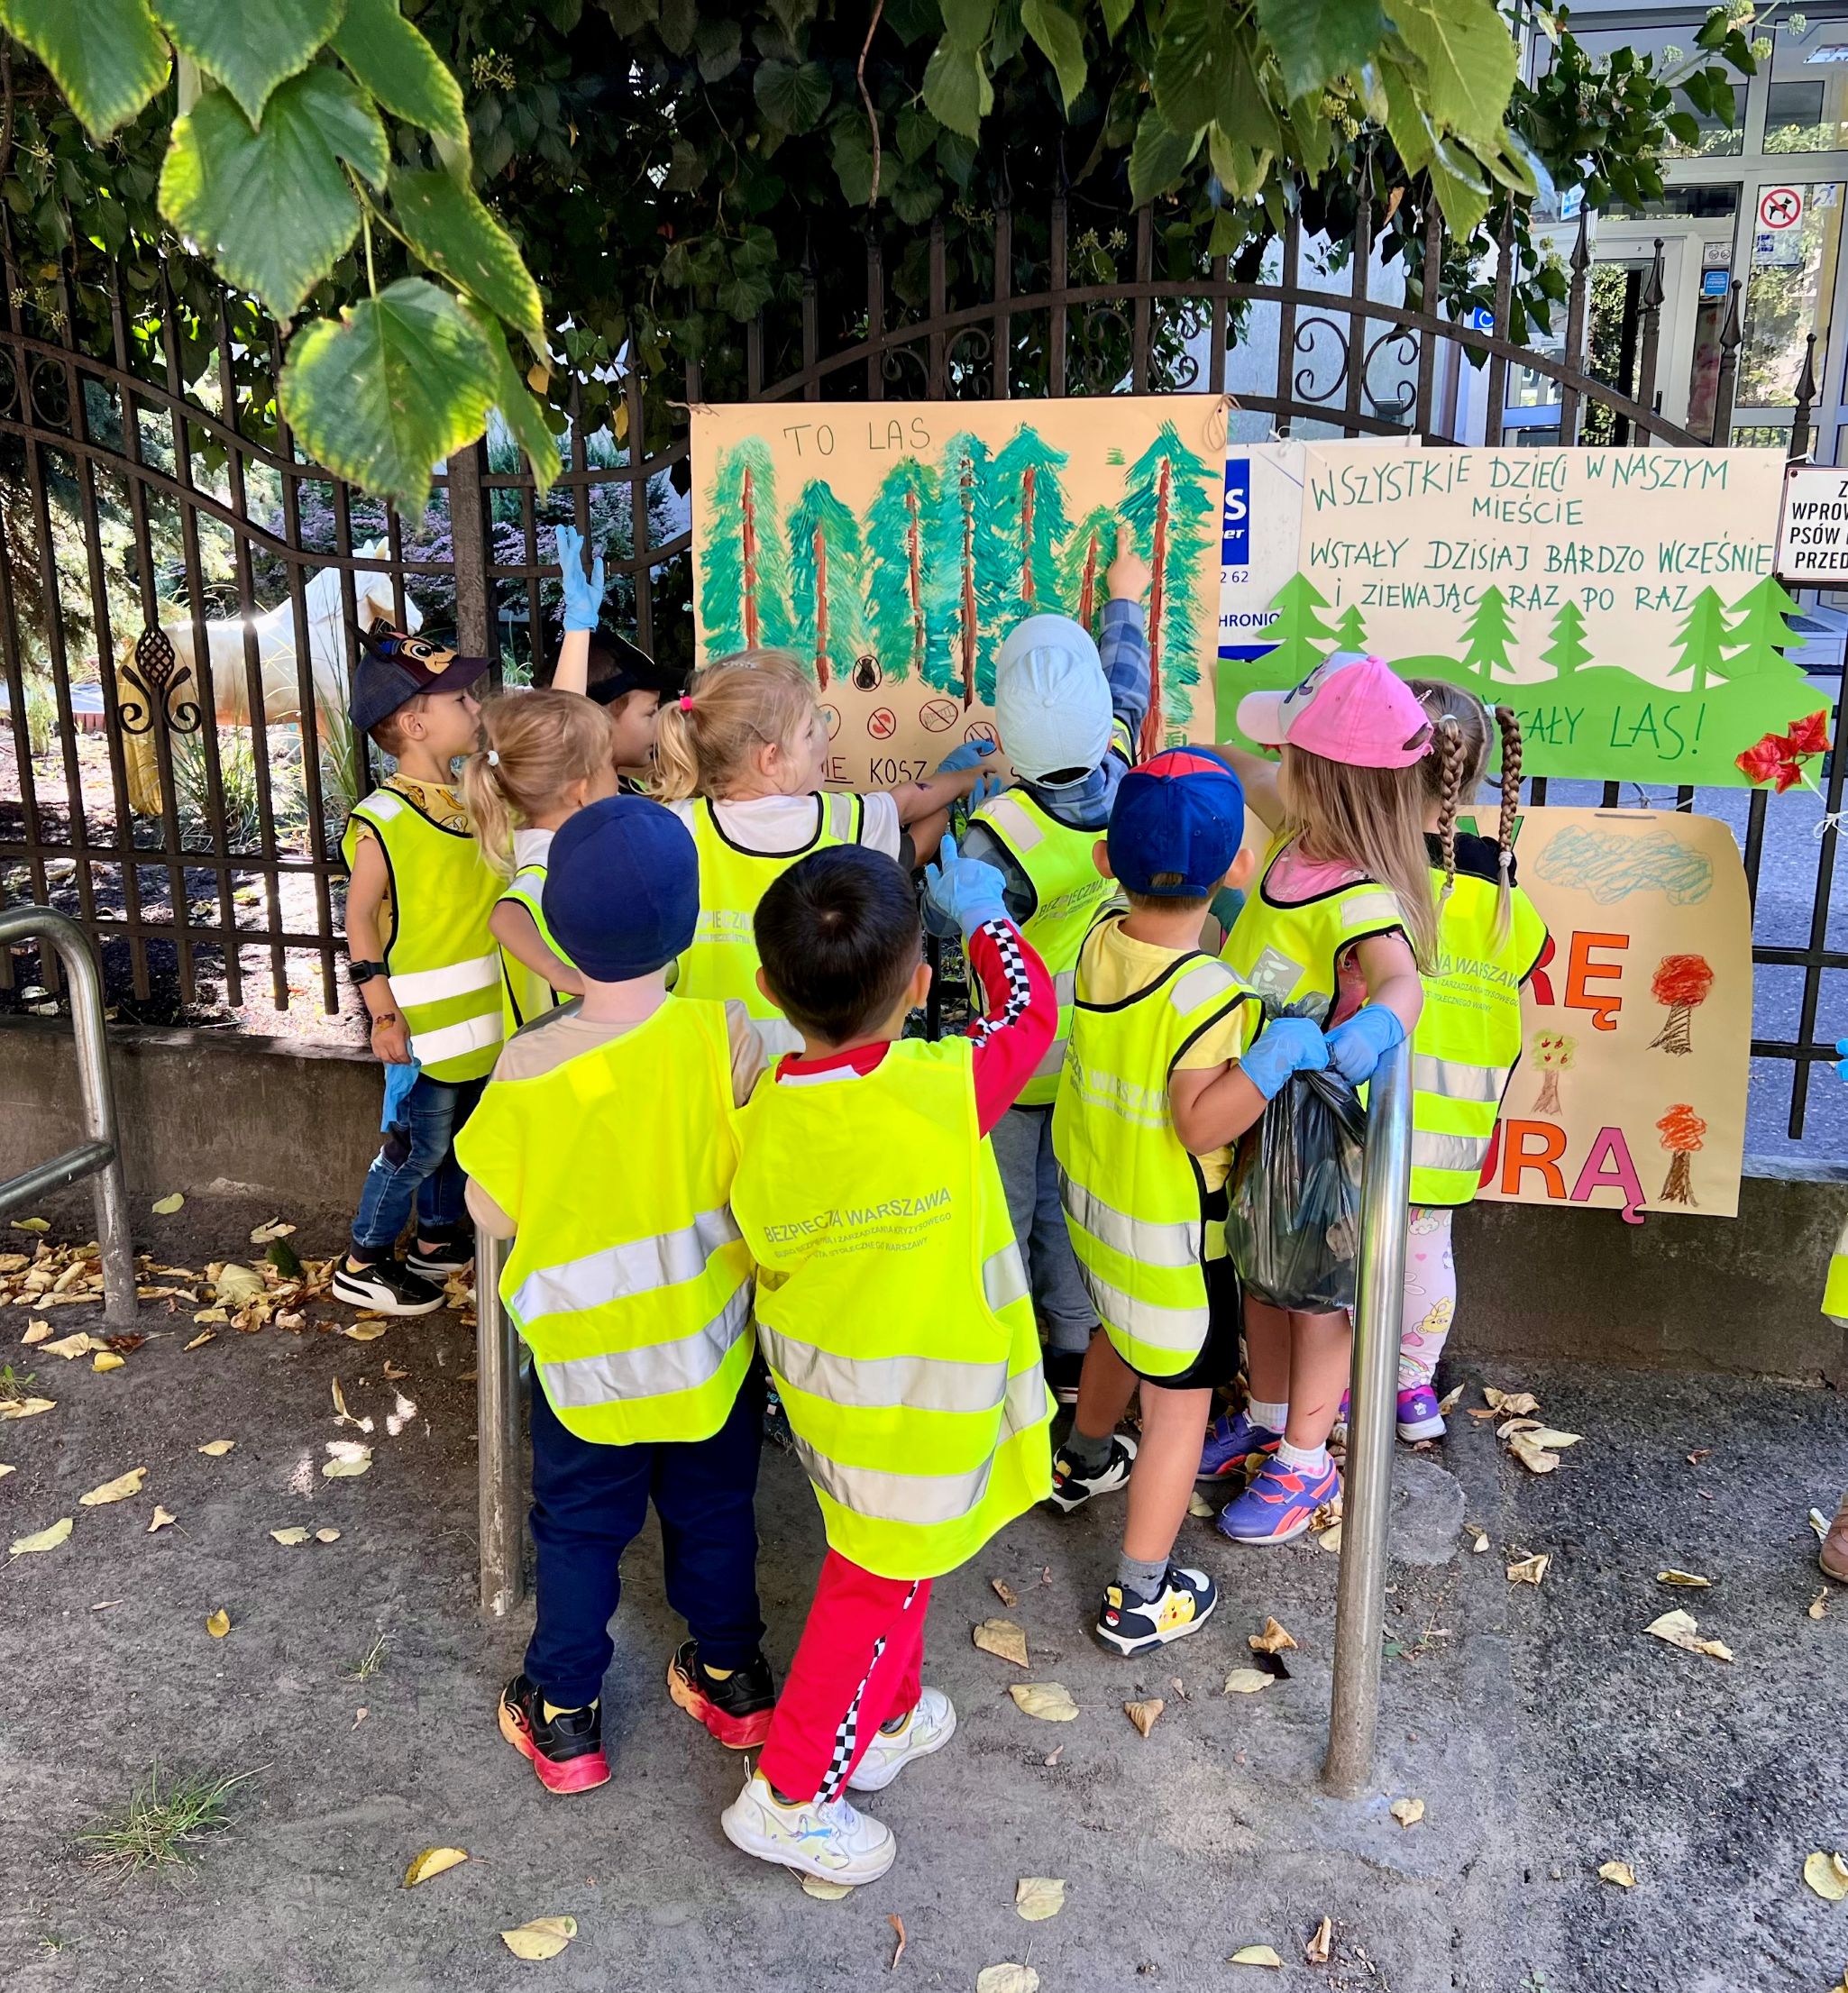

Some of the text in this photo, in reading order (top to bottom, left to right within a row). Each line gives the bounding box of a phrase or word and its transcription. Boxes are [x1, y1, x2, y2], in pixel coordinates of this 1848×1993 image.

[782, 416, 931, 456] TO LAS
[1586, 453, 1606, 480] W
[1611, 453, 1729, 490] NASZYM
[1789, 522, 1841, 545] PSÓW
[1311, 537, 1409, 570] WSTAŁY
[1543, 541, 1644, 575] BARDZO
[1231, 570, 1249, 584] 62
[1509, 583, 1560, 612] RAZ
[1580, 586, 1615, 613] PO
[1634, 585, 1688, 613] RAZ
[1610, 702, 1706, 761] LAS!
[845, 1186, 952, 1227] WARSZAWA
